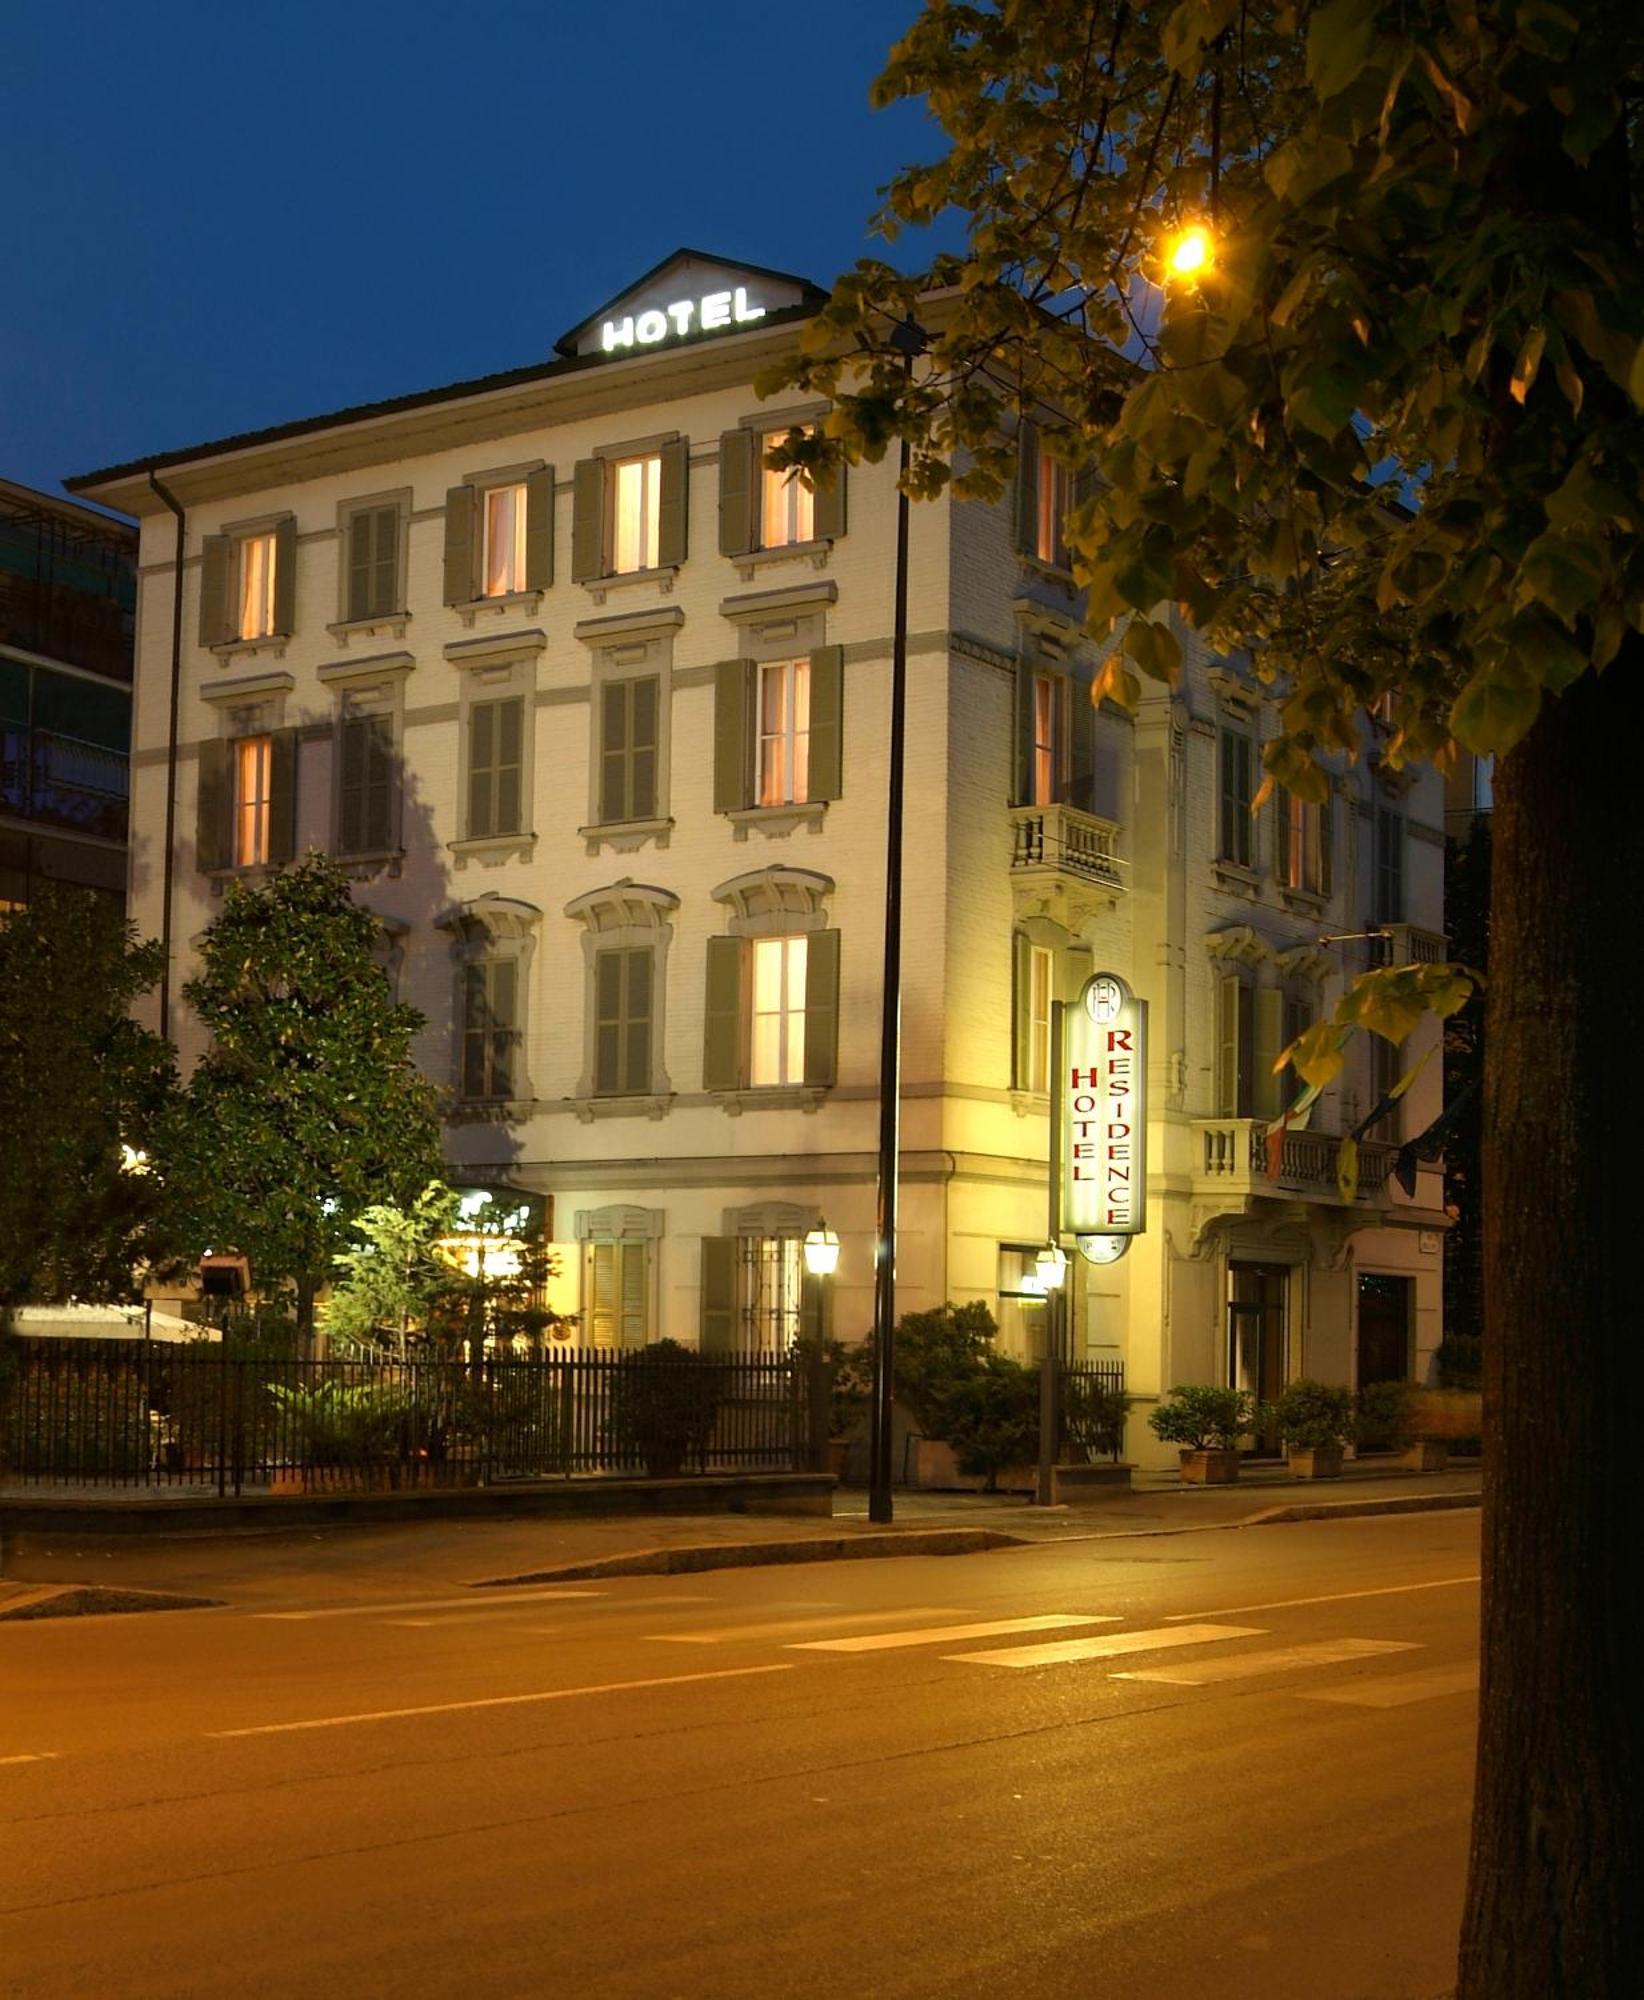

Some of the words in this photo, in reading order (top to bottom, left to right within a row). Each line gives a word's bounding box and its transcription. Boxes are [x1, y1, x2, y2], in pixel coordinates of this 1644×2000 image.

[602, 287, 766, 351] HOTEL
[1071, 1068, 1098, 1180] HOTEL
[1107, 1030, 1133, 1224] RESIDENCE
